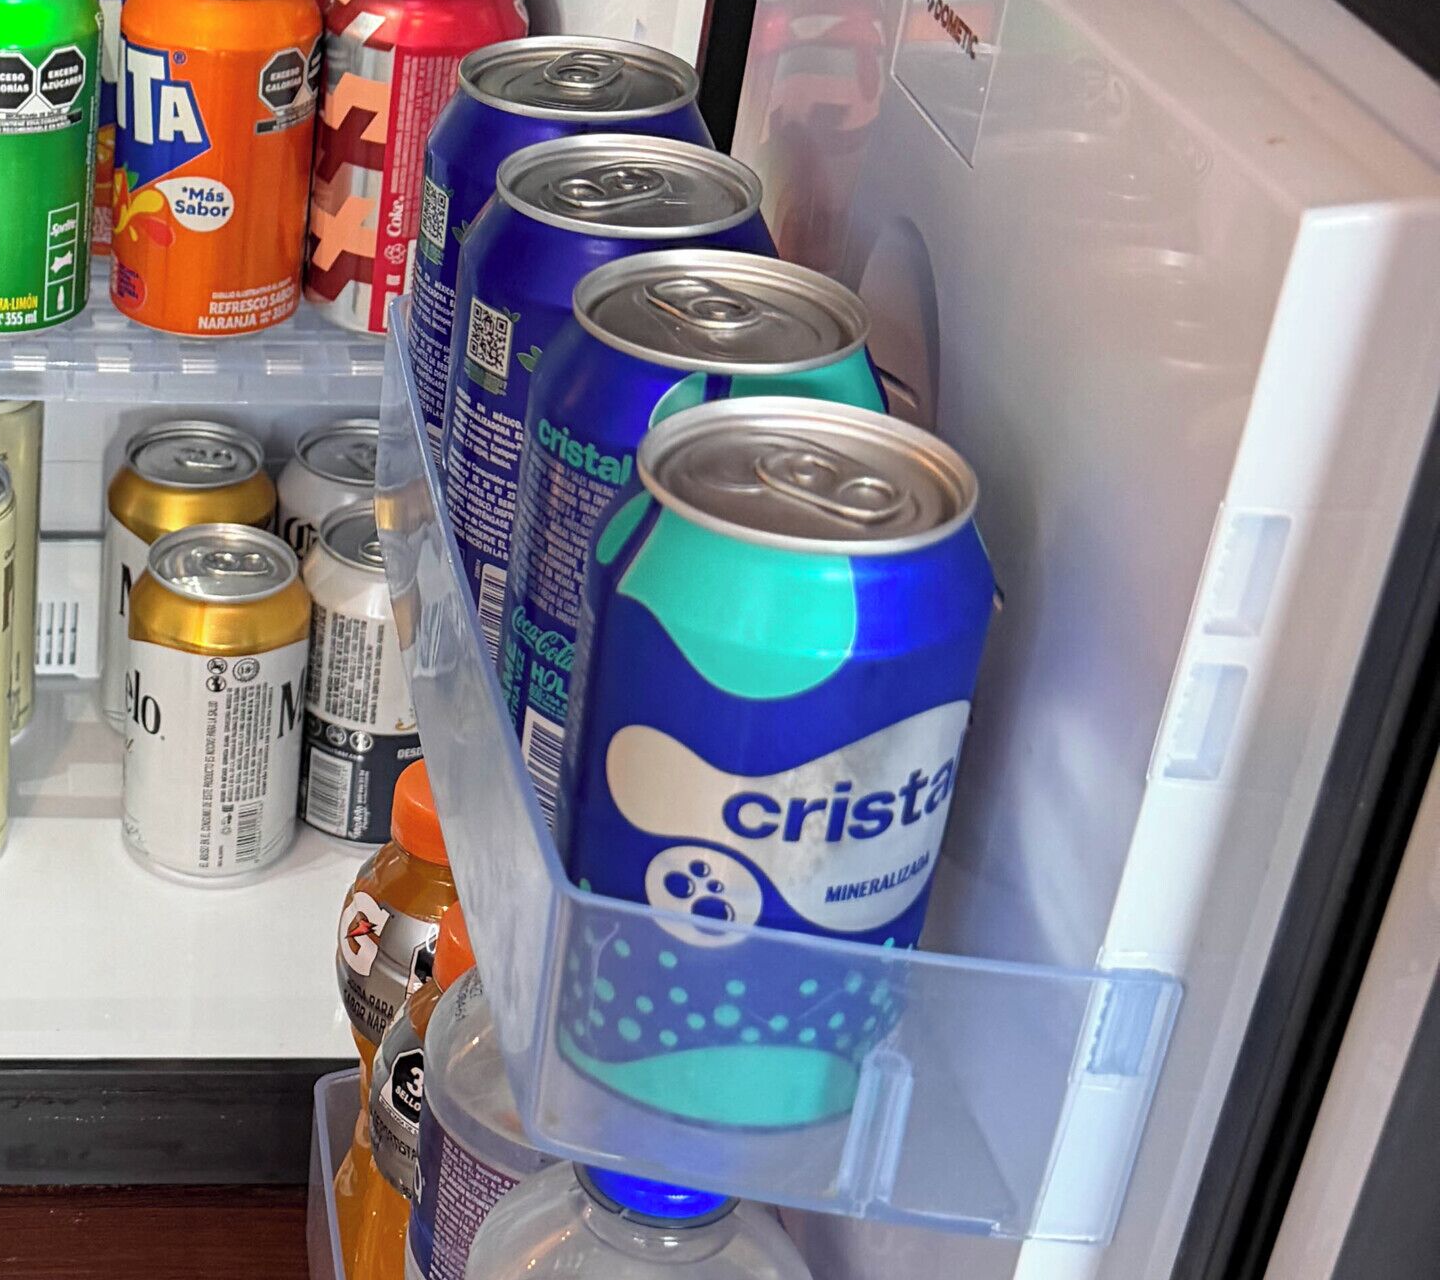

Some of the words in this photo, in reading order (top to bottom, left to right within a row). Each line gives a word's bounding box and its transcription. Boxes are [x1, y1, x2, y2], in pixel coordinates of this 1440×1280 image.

[48, 65, 79, 80] EXCESO
[175, 200, 230, 217] Sabor
[209, 296, 268, 315] REFRESCO
[4, 311, 23, 325] 355
[198, 313, 257, 330] NARANJA
[537, 417, 633, 486] cristal
[531, 660, 569, 701] HOL
[721, 755, 955, 843] crista
[369, 994, 395, 1019] PARA
[367, 1011, 388, 1034] NAR
[406, 1066, 424, 1098] 3
[394, 1085, 422, 1113] SELLO
